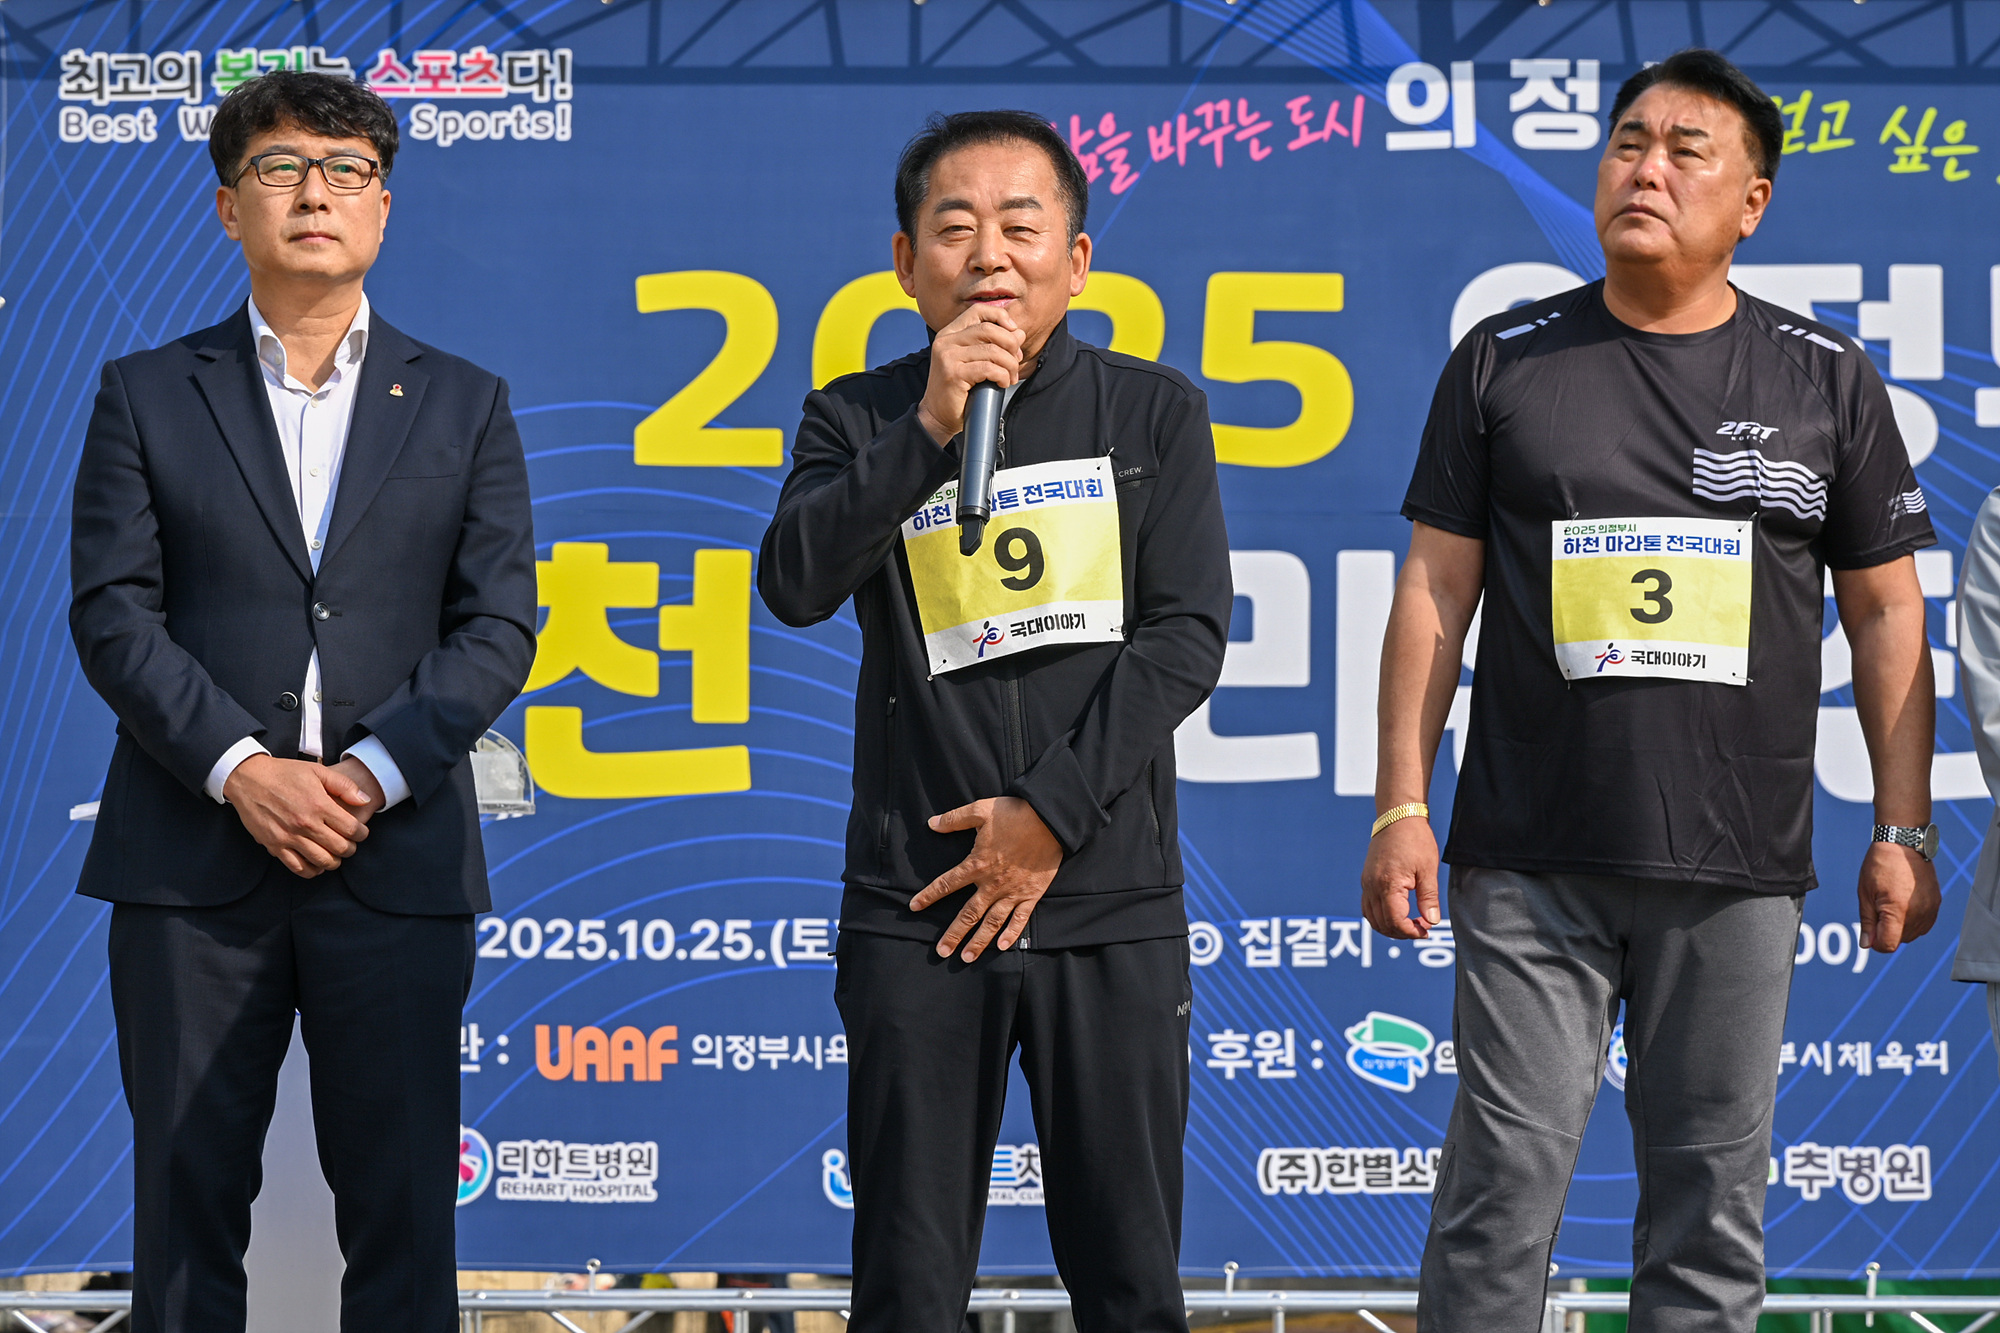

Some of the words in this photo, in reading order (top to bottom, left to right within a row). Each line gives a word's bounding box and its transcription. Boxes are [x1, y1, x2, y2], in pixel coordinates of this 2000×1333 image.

[61, 51, 199, 103] 최고의
[368, 49, 572, 100] 스포츠다!
[61, 108, 155, 141] Best
[412, 103, 571, 147] Sports!
[1147, 97, 1273, 168] 바꾸는
[1285, 94, 1365, 148] 도시
[1879, 105, 1981, 182] 싶은
[912, 503, 952, 531] 하천
[1022, 478, 1104, 505] 전국대회
[1598, 523, 1637, 534] 의정부시
[994, 527, 1045, 592] 9
[1563, 537, 1600, 555] 하천
[1605, 535, 1662, 552] 마라톤
[1666, 535, 1741, 556] 전국대회
[1629, 568, 1674, 625] 3
[1009, 612, 1087, 639] 국대이야기
[521, 541, 752, 799] 천
[1630, 649, 1707, 669] 국대이야기
[477, 917, 840, 969] 2025.10.25.(토
[1238, 916, 1373, 969] 집결지
[534, 1023, 679, 1083] UAAF
[1206, 1028, 1298, 1081] 후원
[500, 1142, 654, 1181] 리하트병원
[1788, 1147, 1931, 1200] 추병원
[501, 1181, 566, 1197] REHART
[572, 1182, 652, 1198] HOSPITAL
